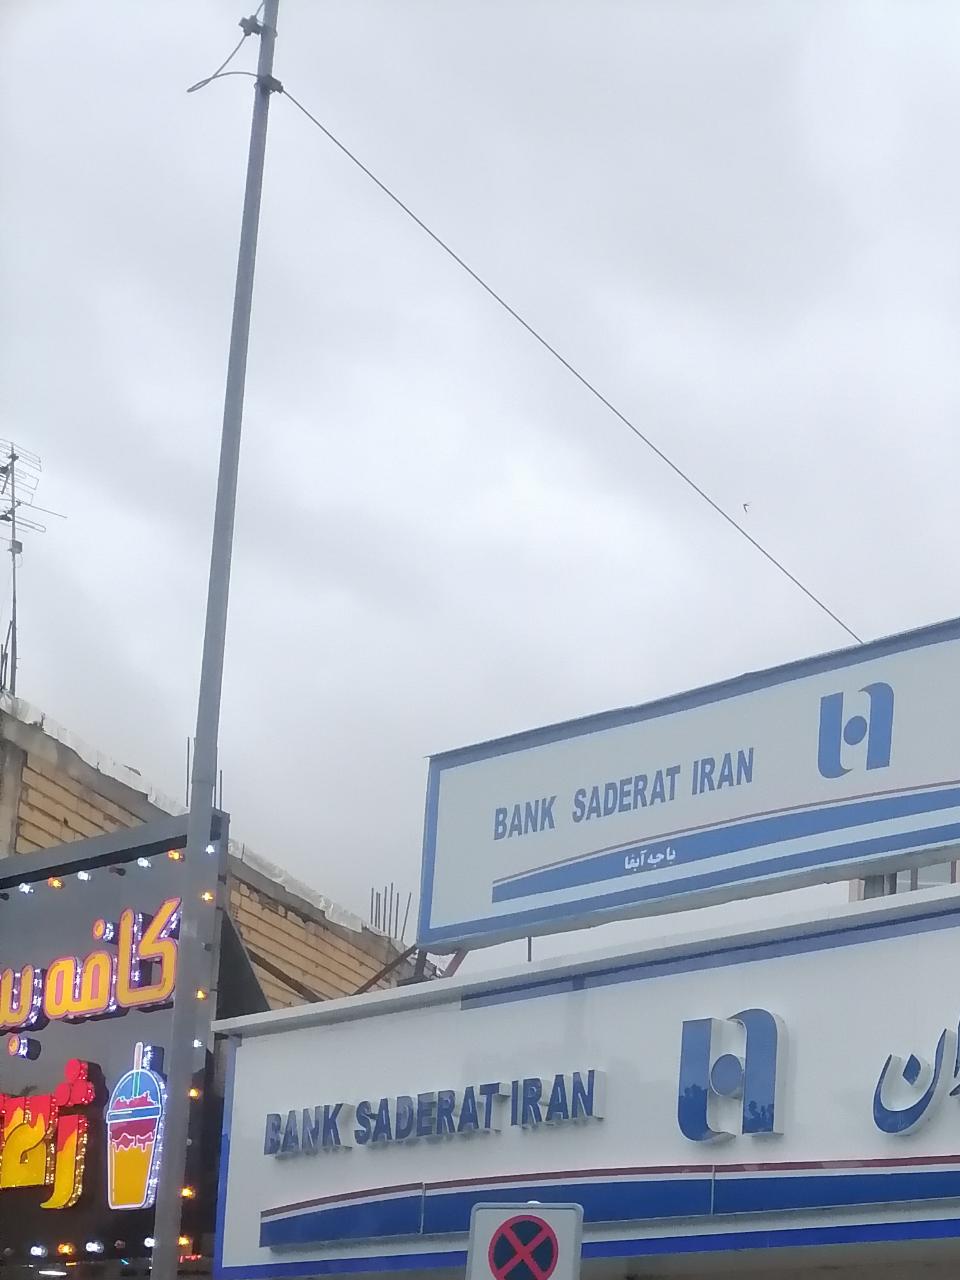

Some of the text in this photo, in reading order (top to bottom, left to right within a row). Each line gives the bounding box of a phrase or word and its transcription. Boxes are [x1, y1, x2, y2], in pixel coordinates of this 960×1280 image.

[494, 747, 754, 841] BANK SADERAT IRAN
[44, 896, 182, 1020] کافه
[263, 1069, 603, 1157] BANK SADERAT IRAN
